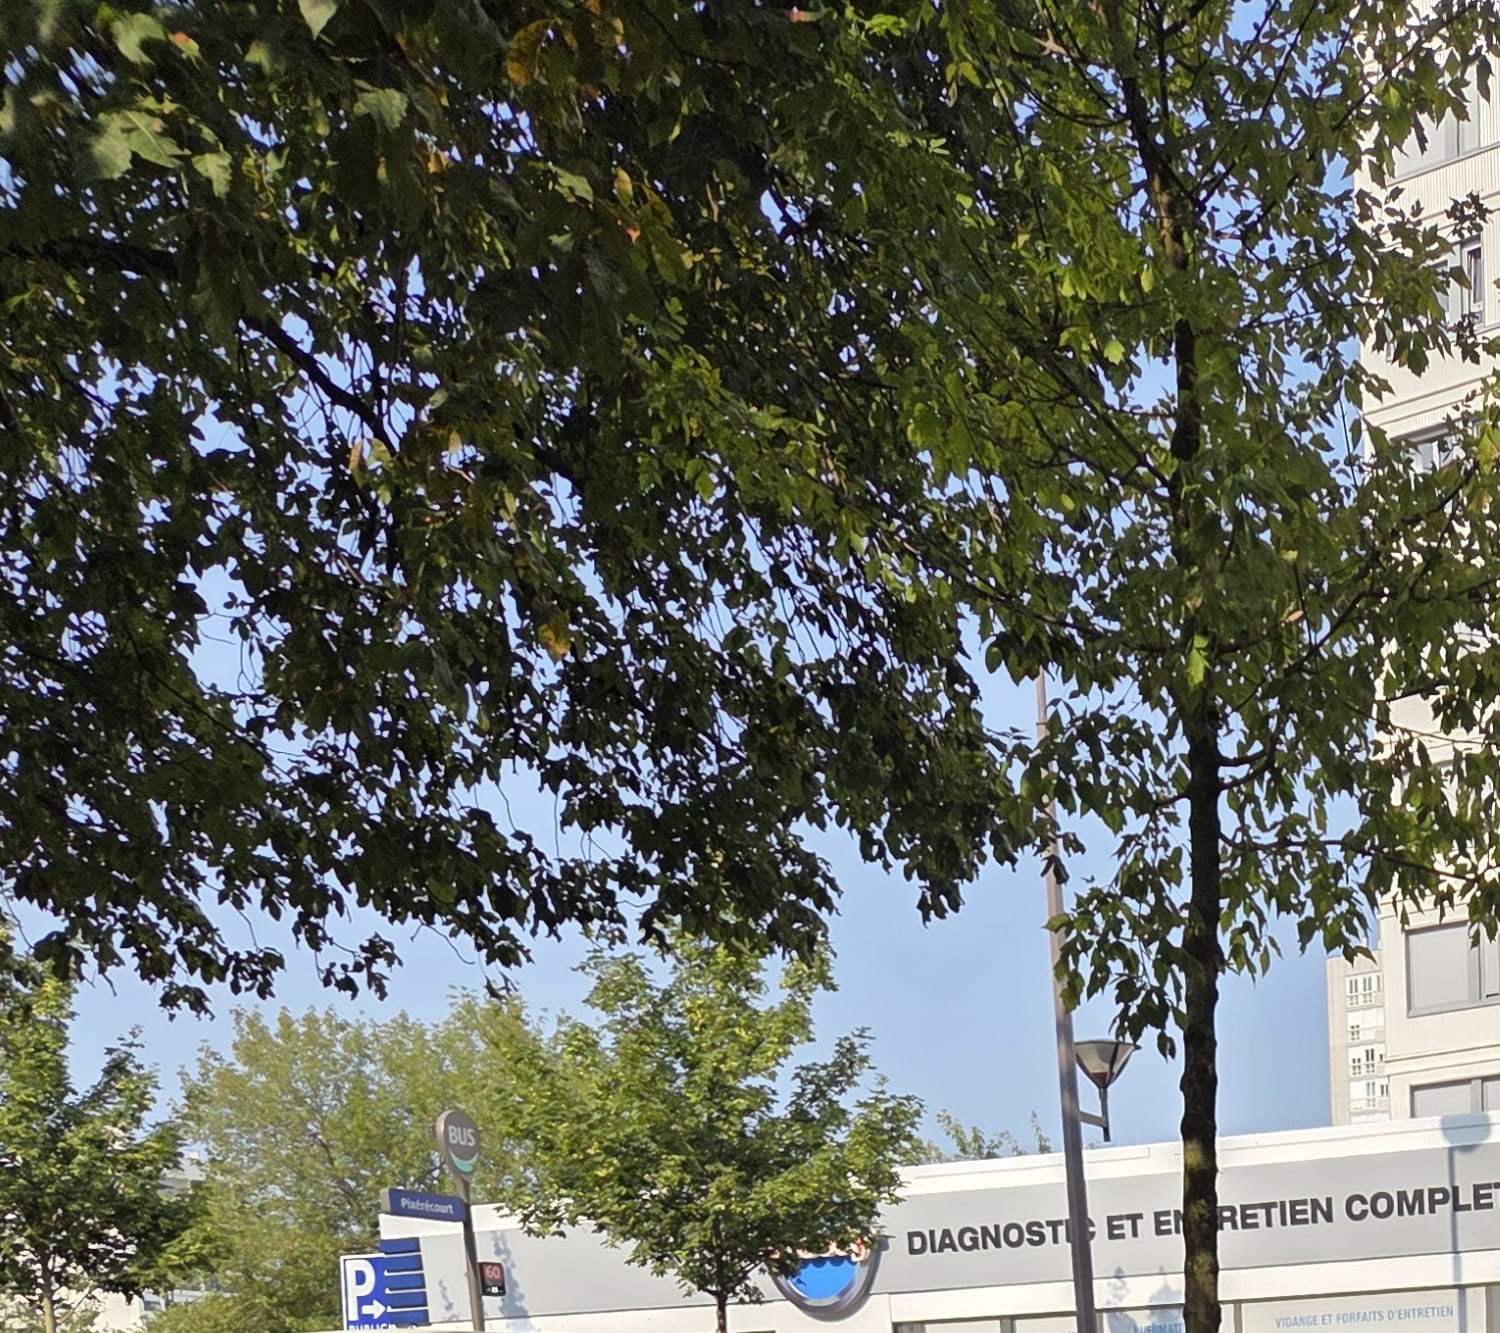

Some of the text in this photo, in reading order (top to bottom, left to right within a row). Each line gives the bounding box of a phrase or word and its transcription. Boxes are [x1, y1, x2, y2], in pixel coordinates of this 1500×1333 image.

[448, 1125, 476, 1147] BUS
[1106, 1212, 1144, 1241] ET
[345, 1259, 376, 1321] P
[1275, 1305, 1454, 1329] VIDANGE ET FORFAITS D'ENTRETIEN
